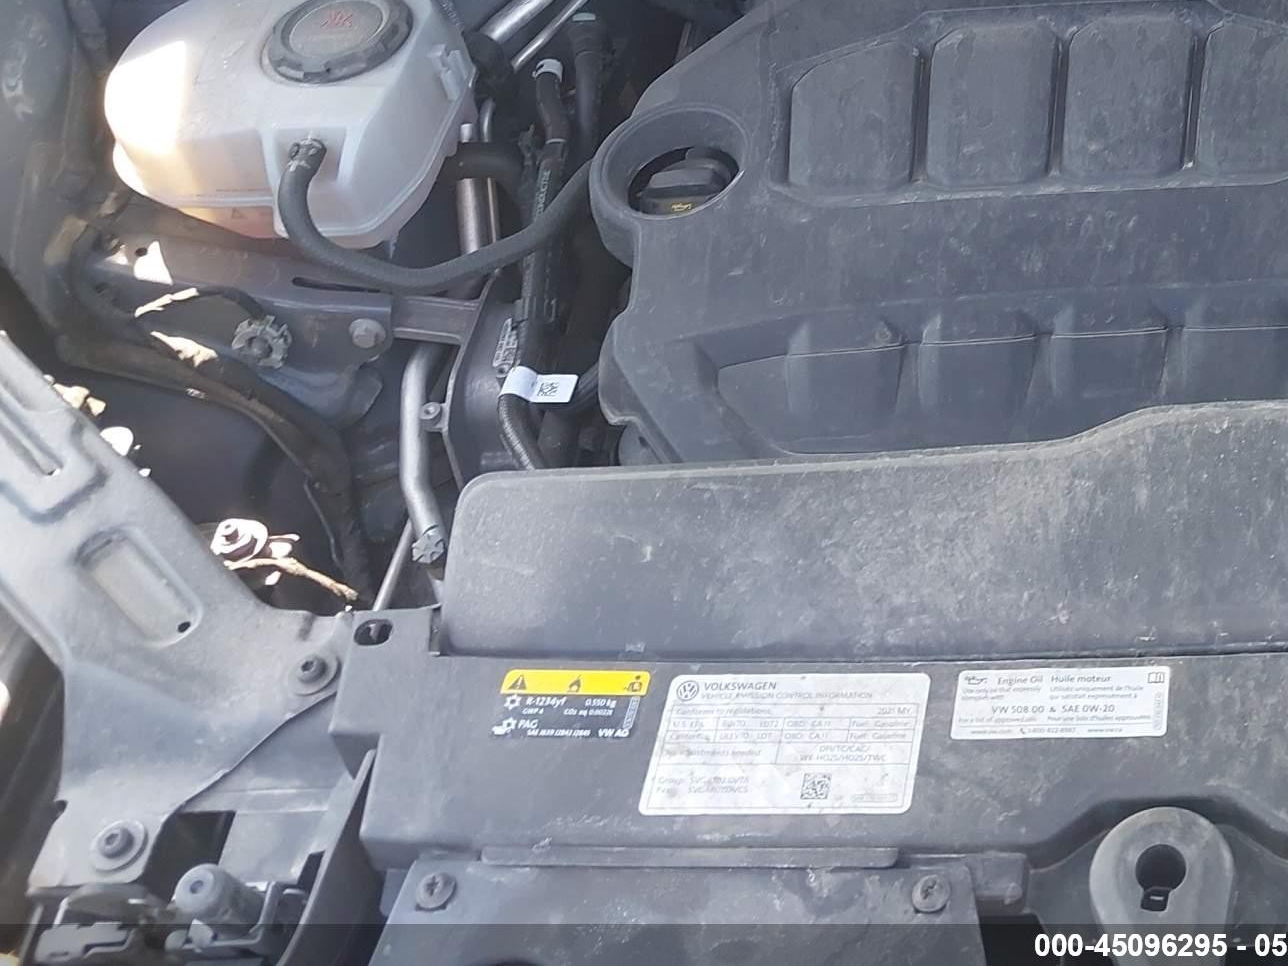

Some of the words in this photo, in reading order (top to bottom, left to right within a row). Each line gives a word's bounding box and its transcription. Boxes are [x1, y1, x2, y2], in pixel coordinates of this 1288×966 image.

[997, 676, 1028, 686] Engine
[1030, 675, 1043, 684] Oil
[1051, 674, 1076, 683] Huile
[1076, 675, 1112, 683] moteur
[704, 681, 777, 691] VOLKSWAGEN
[815, 691, 873, 699] INFORMATION
[526, 696, 568, 708] R-1234yf
[585, 698, 607, 707] 0.550
[606, 698, 617, 709] kg
[991, 705, 1010, 714] VW
[1011, 705, 1029, 714] 508
[1031, 705, 1045, 714] 00
[1061, 704, 1080, 713] SAE
[1082, 704, 1115, 713] 0W-20
[518, 719, 539, 729] PAG
[598, 728, 615, 737] VW
[614, 729, 630, 737] AG
